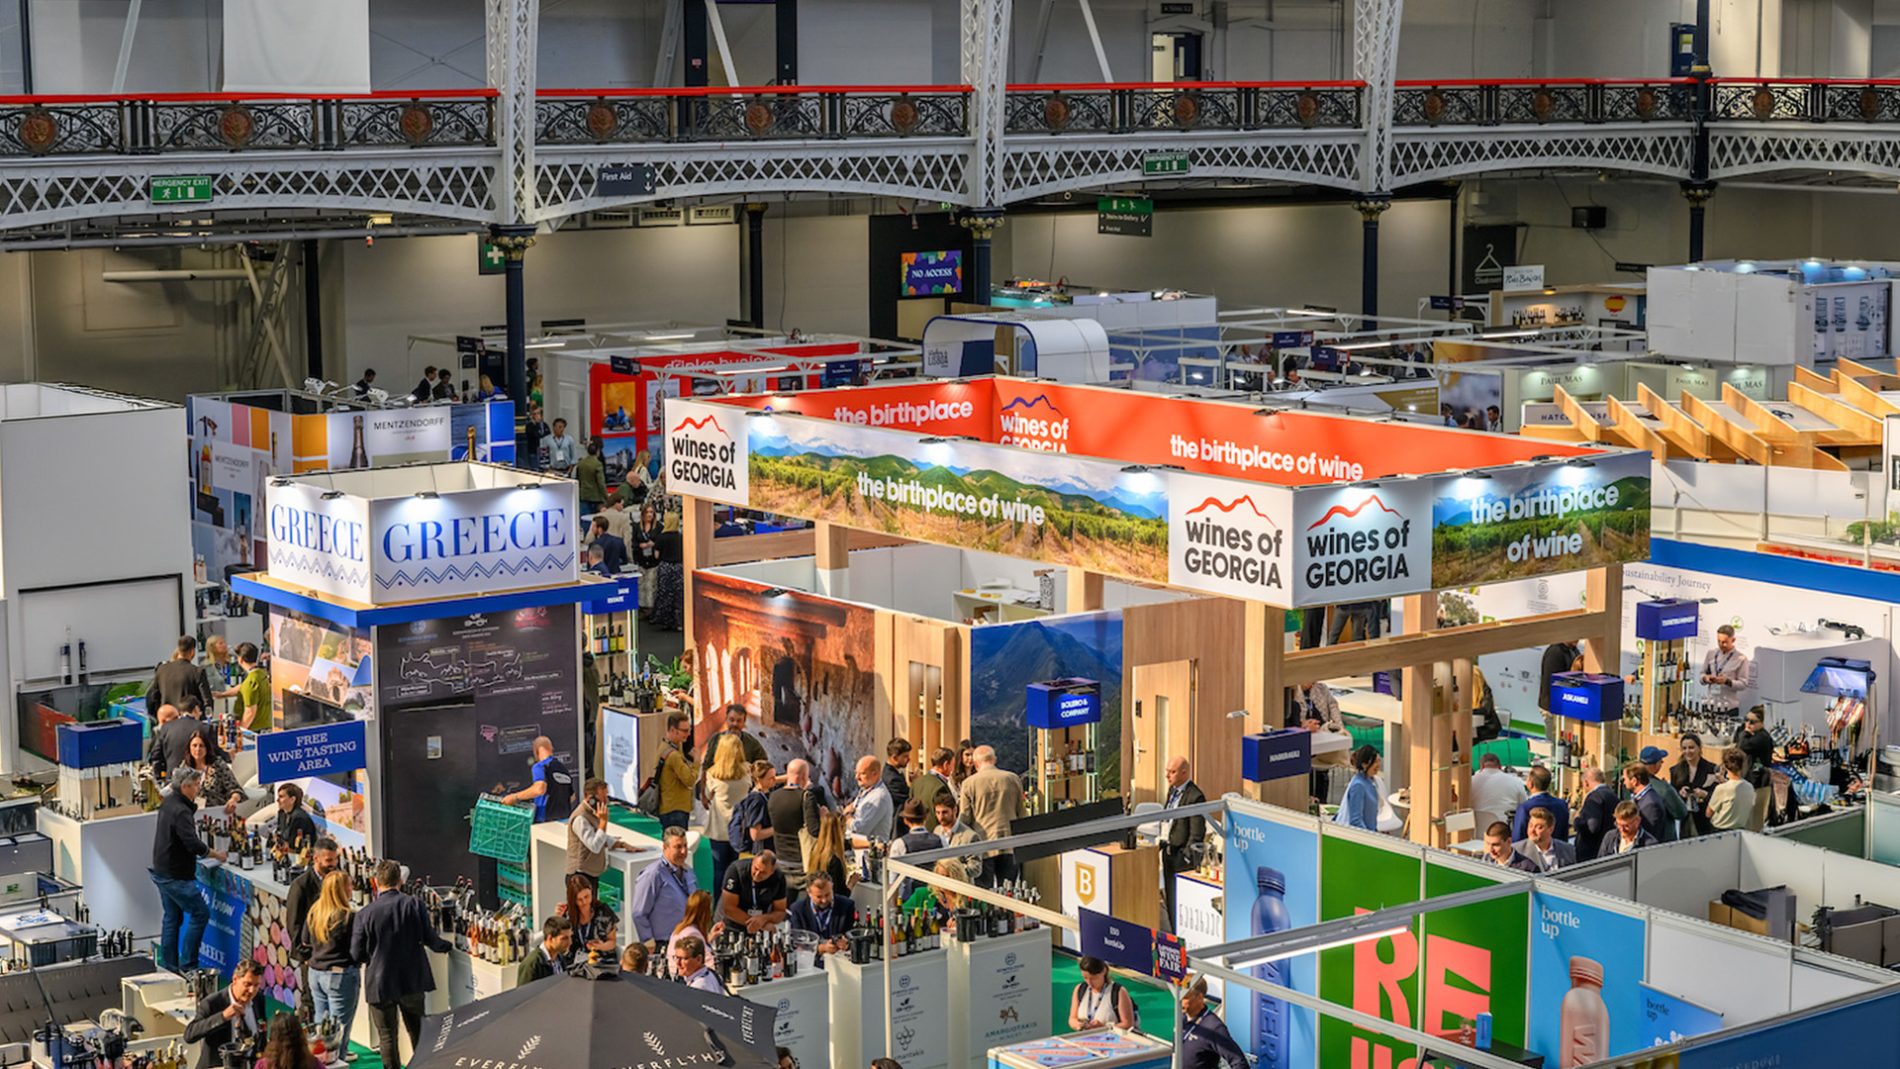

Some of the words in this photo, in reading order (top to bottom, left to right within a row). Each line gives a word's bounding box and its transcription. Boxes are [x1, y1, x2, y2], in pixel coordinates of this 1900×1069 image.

[602, 172, 618, 180] First
[620, 172, 632, 180] Aid
[912, 270, 923, 278] NO
[924, 268, 952, 278] ACCESS
[1564, 374, 1583, 384] MAS
[1744, 379, 1763, 390] MAS
[374, 416, 444, 430] MENTZENDORFF
[834, 406, 868, 426] the
[870, 399, 972, 428] birthplace
[1000, 411, 1048, 440] wines
[1051, 418, 1069, 440] of
[672, 435, 718, 462] wines
[720, 442, 736, 464] of
[1170, 434, 1198, 460] the
[1201, 438, 1294, 472] birthplace
[1296, 452, 1318, 475] of
[1320, 453, 1364, 481] wine
[672, 460, 736, 490] GEORGIA
[857, 471, 884, 498] the
[886, 474, 977, 515] birthplace
[980, 496, 998, 518] of
[1000, 499, 1044, 526] wine
[1470, 497, 1506, 525] the
[1509, 486, 1620, 520] birthplace
[271, 503, 364, 563] GREECE
[383, 508, 567, 564] GREECE
[1186, 518, 1252, 552] wines
[1257, 529, 1282, 558] of
[1306, 527, 1380, 558] wines
[1384, 519, 1410, 549] of
[1507, 533, 1531, 563] of
[1533, 530, 1584, 560] wine
[1184, 547, 1282, 590] GEORGIA
[1306, 553, 1410, 590] GEORGIA
[1678, 574, 1712, 593] Journey
[1060, 706, 1090, 718] COMPANY
[296, 732, 328, 747] FREE
[268, 748, 303, 764] WINE
[304, 740, 357, 758] TASTING
[297, 758, 332, 772] AREA
[1234, 822, 1265, 843] bottle
[1234, 838, 1248, 852] up
[1079, 868, 1092, 896] B
[1542, 904, 1581, 929] bottle
[1542, 923, 1560, 940] up
[198, 941, 227, 966] REECE
[1159, 950, 1181, 962] WINE
[1160, 960, 1182, 974] FAIR
[1646, 998, 1670, 1016] bottle
[455, 1056, 542, 1069] EVERF
